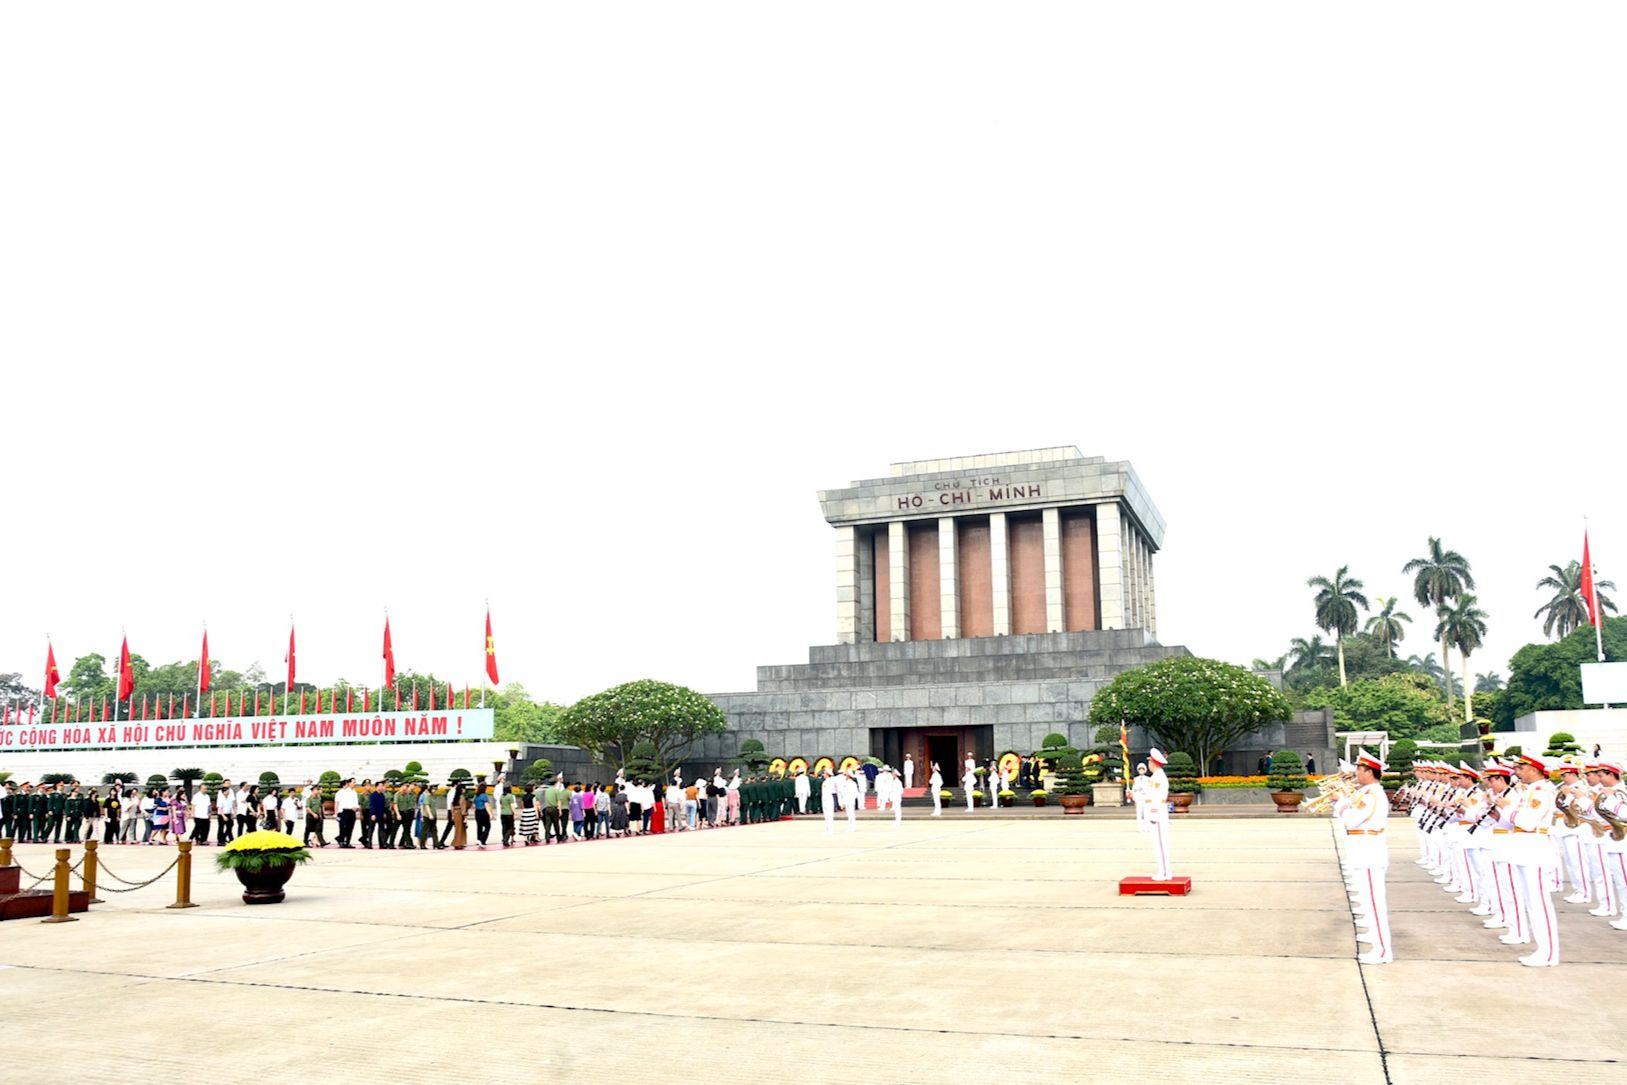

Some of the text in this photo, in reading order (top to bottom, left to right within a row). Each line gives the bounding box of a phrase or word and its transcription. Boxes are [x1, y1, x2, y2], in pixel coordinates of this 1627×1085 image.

[19, 726, 57, 748] CỘNG
[62, 725, 91, 744] HÒA
[97, 724, 117, 743] XÃ
[123, 723, 149, 745] HỘI
[155, 720, 186, 742] CHỦ
[193, 720, 243, 741] NGHĨA
[251, 718, 288, 742] VIỆT
[295, 720, 334, 738] NAM
[342, 715, 396, 737] MUÔN
[404, 713, 448, 736] NĂM
